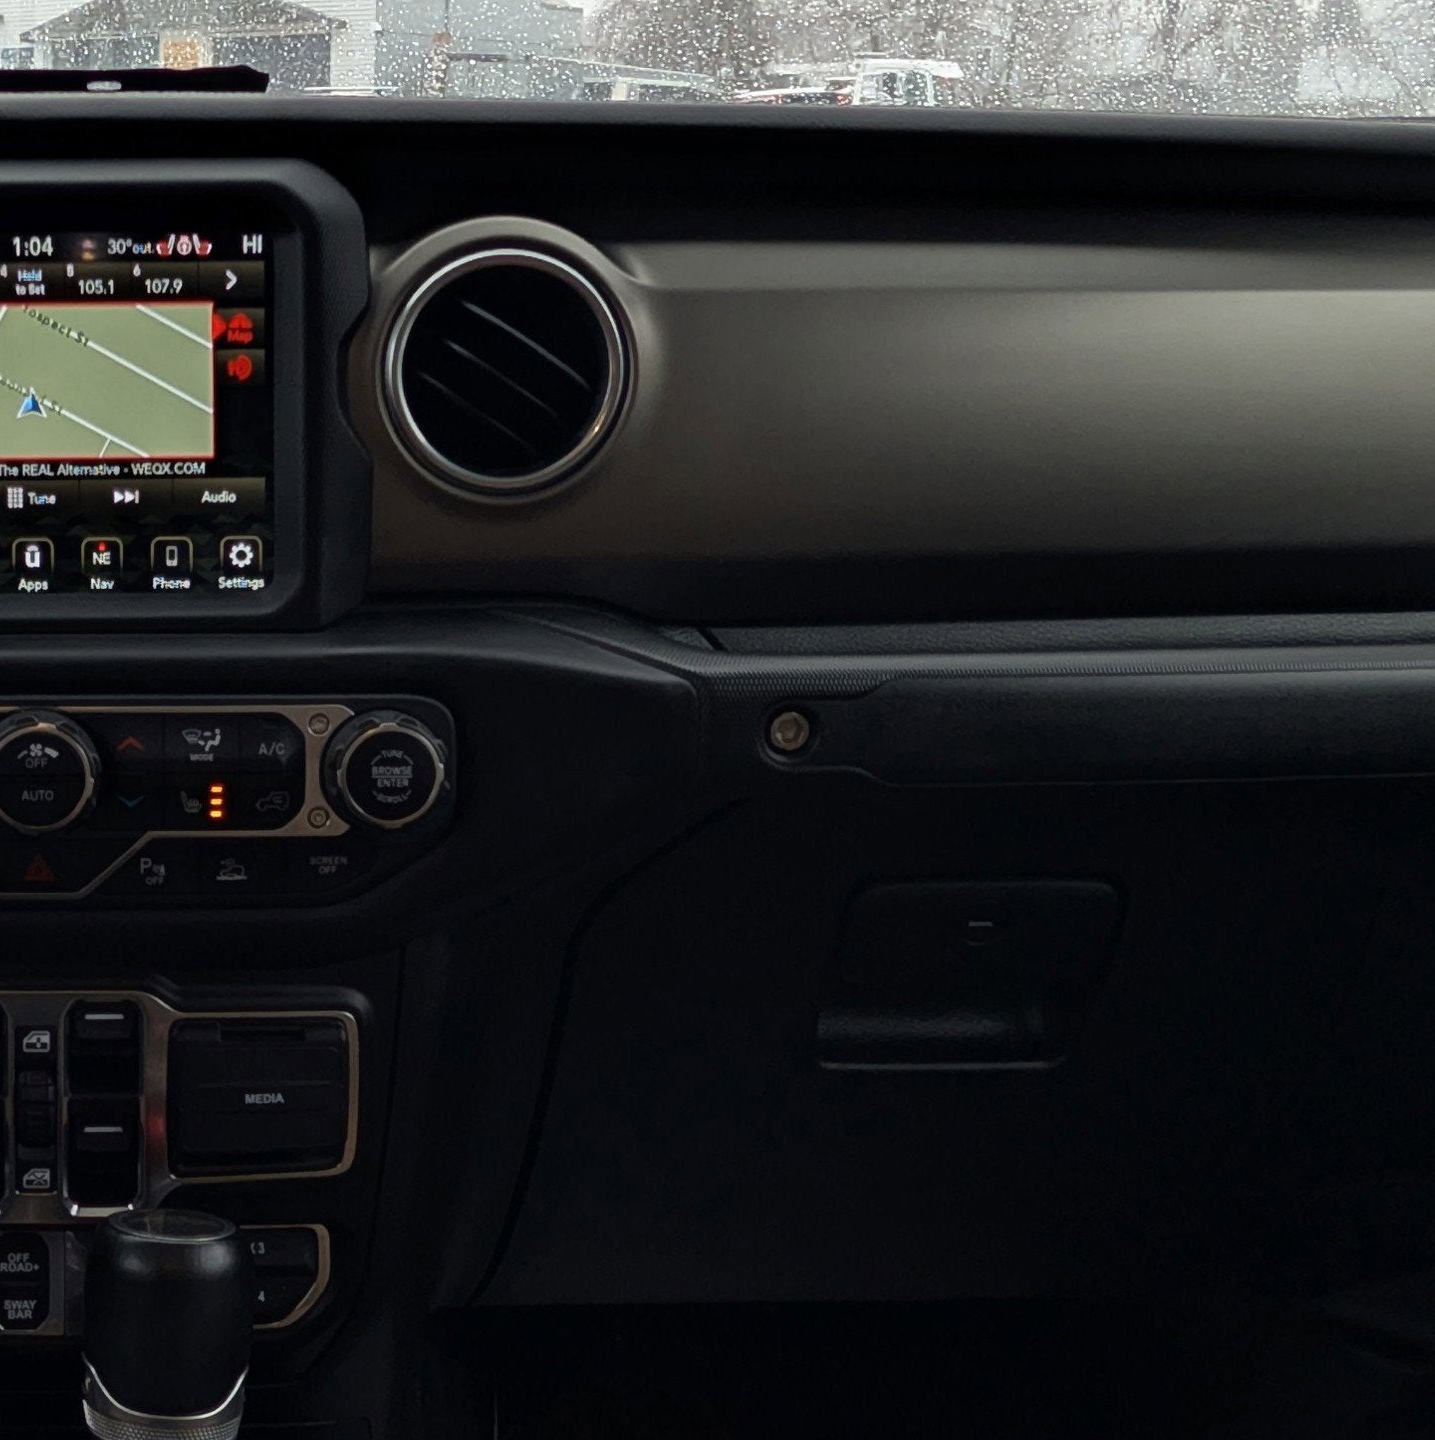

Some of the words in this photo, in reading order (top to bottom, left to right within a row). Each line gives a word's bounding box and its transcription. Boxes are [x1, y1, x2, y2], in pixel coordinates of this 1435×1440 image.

[12, 236, 53, 257] 1:04
[243, 234, 263, 254] HI
[79, 279, 114, 295] 105.1
[145, 279, 182, 295] 107.9
[22, 463, 54, 476] REAL
[57, 462, 120, 476] Alternative
[131, 462, 205, 475] WEQX.COM
[28, 491, 56, 504] Tune
[202, 490, 236, 503] Audio
[92, 551, 111, 565] NE
[18, 578, 49, 592] Apps
[90, 577, 114, 590] Nav
[153, 576, 191, 590] Phone
[218, 576, 265, 591] Settings
[258, 742, 286, 757] A/C
[26, 758, 48, 770] OFF
[21, 789, 55, 802] AUTO
[245, 1093, 284, 1104] MEDIA
[7, 1253, 30, 1263] OFF
[257, 1290, 265, 1303] 4
[4, 1300, 36, 1311] SWAY
[7, 1310, 33, 1320] BAR
